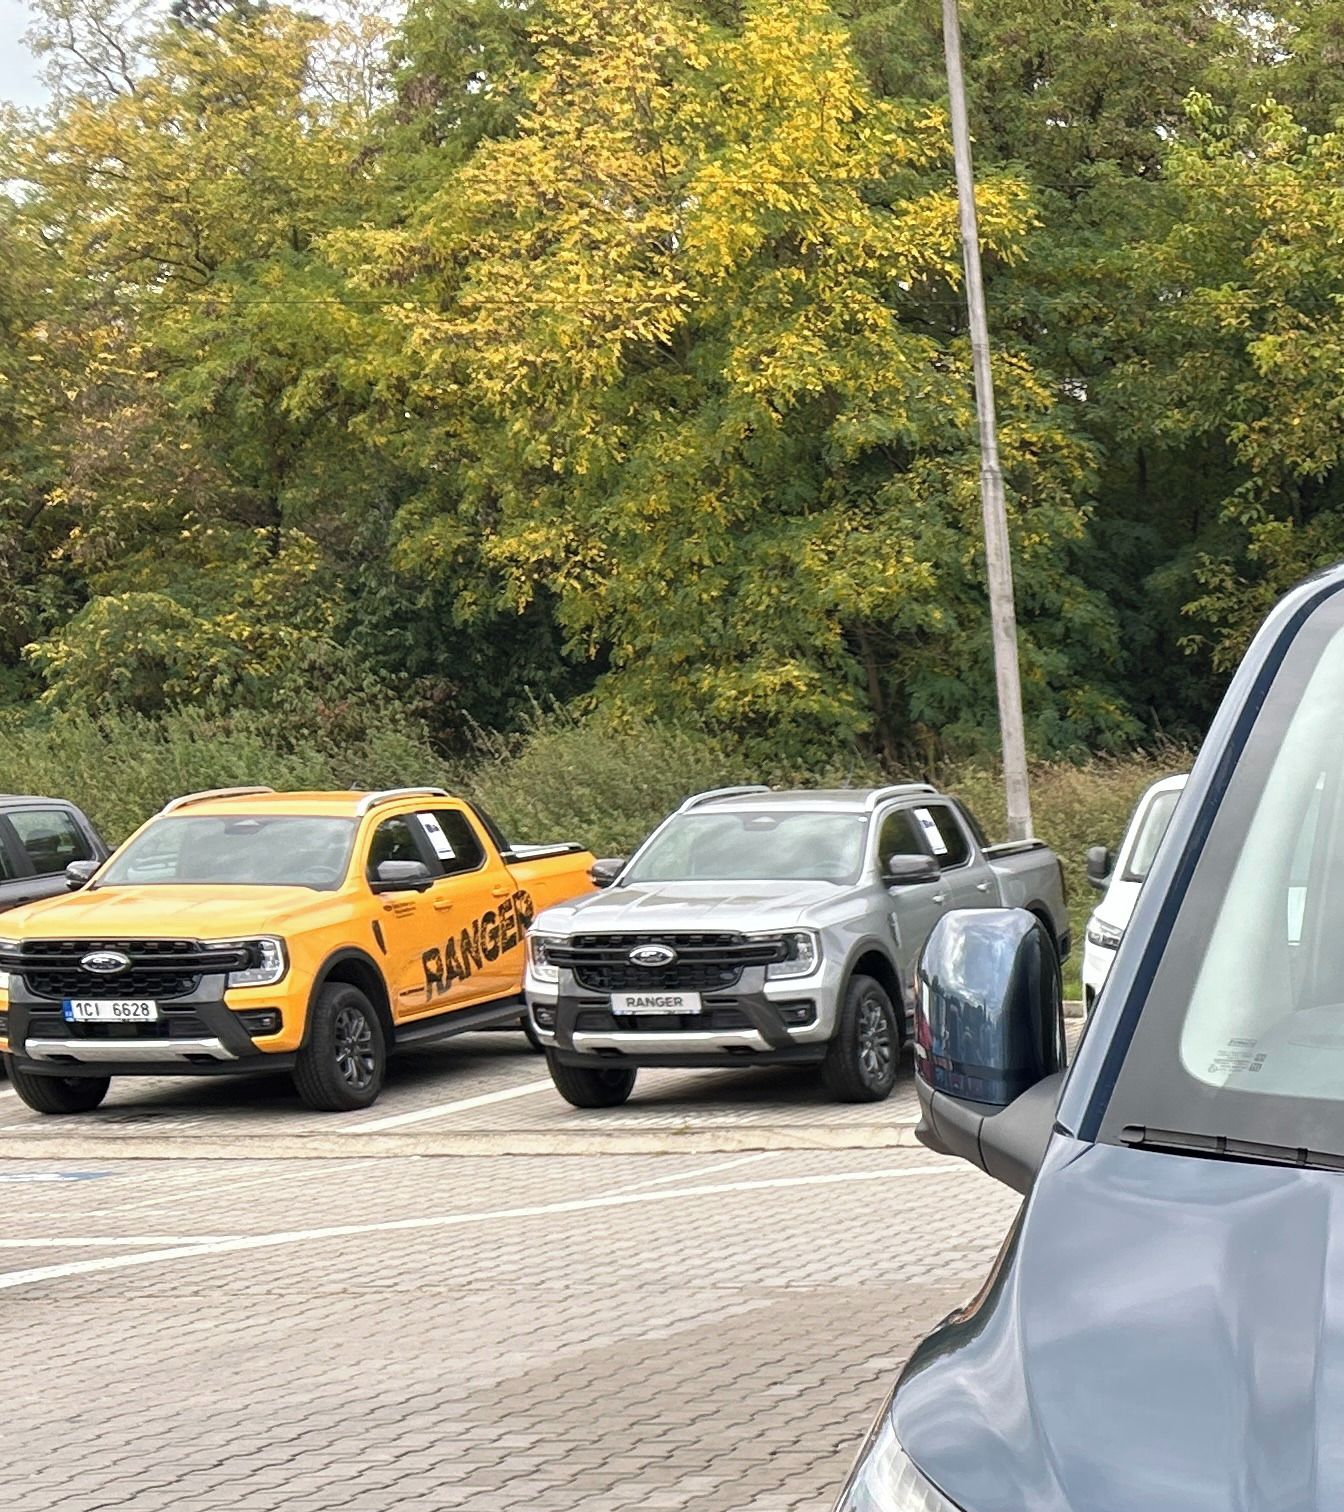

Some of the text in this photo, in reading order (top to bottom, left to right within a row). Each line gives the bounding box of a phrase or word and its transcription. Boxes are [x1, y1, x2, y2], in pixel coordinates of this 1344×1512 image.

[422, 889, 534, 1002] RANGER
[112, 1002, 150, 1017] 6628
[625, 996, 684, 1008] RANGER
